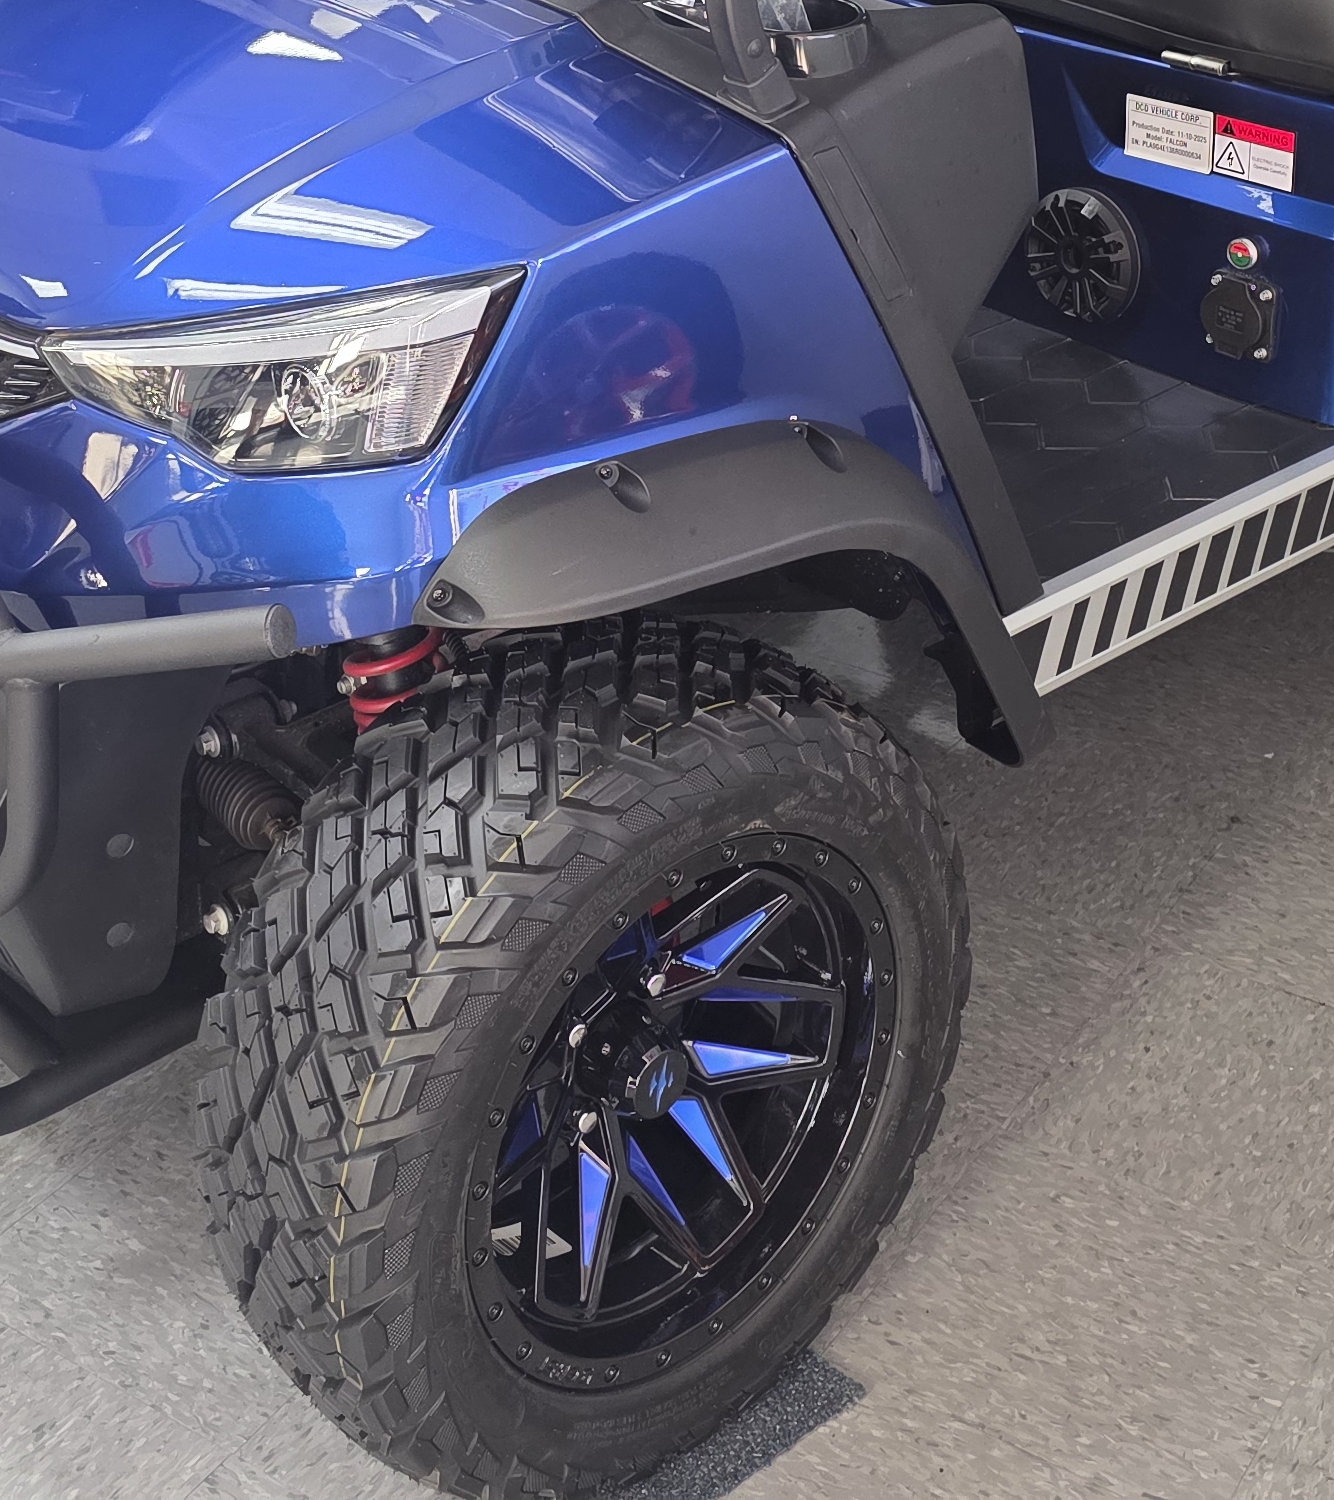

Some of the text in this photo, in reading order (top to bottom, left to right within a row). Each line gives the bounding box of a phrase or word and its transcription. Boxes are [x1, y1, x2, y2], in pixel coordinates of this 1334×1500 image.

[1151, 105, 1178, 119] VEHICLE
[1180, 112, 1202, 125] CORP.
[1132, 120, 1160, 132] Production
[1146, 132, 1188, 148] Model: FALCON
[1238, 124, 1289, 146] WARNING
[1252, 156, 1289, 169] ELECTRIC SHOCK
[1270, 168, 1287, 177] Carefully
